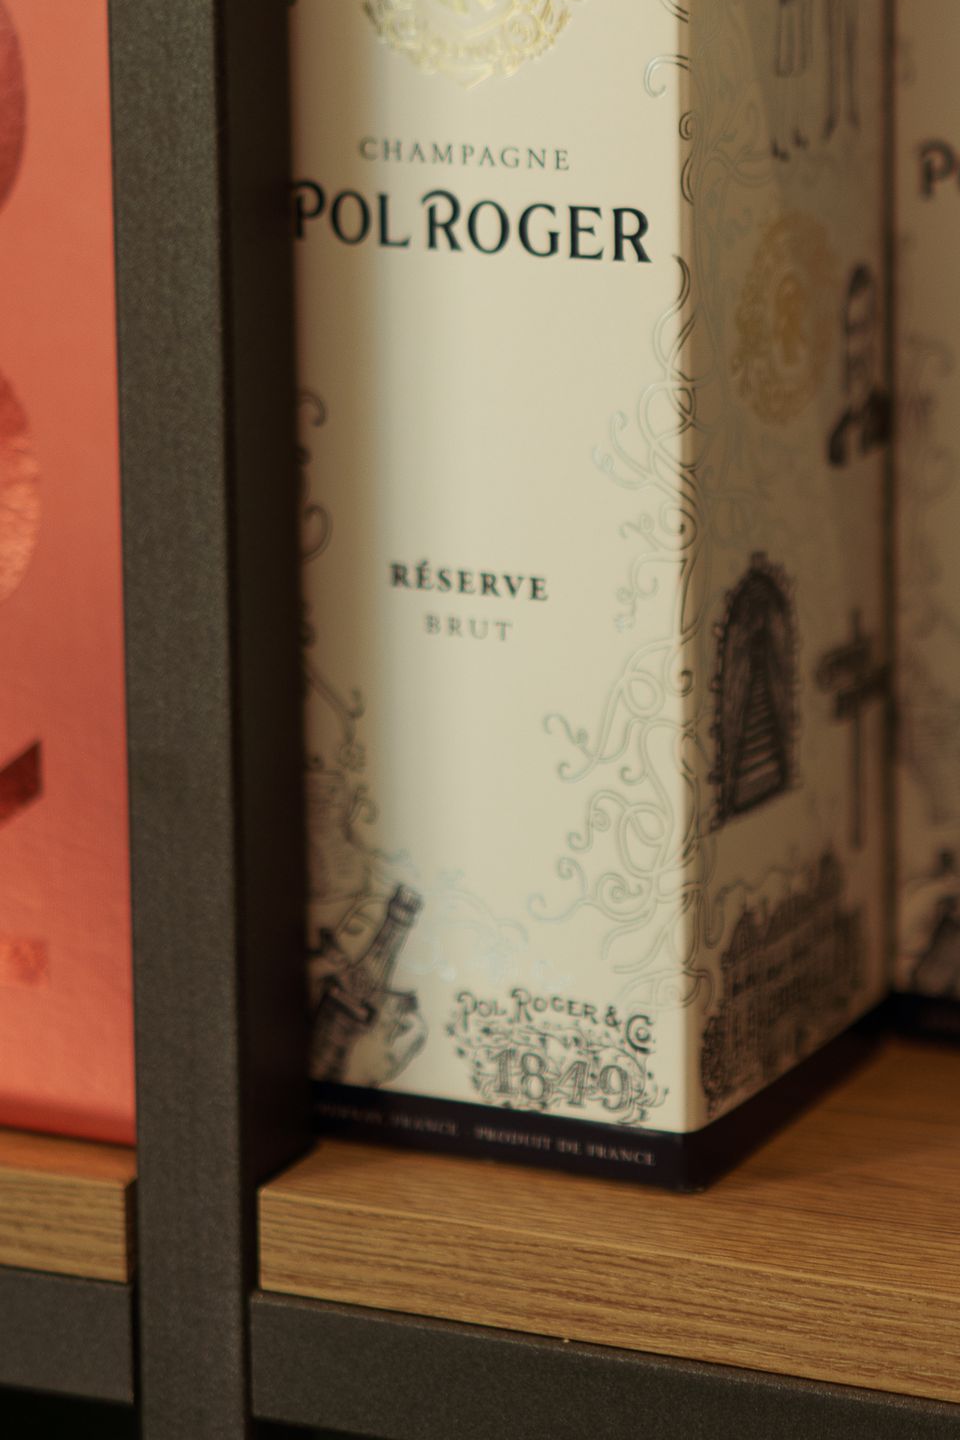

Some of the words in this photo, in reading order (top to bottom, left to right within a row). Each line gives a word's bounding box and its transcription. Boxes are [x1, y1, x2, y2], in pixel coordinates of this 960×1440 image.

[357, 135, 571, 172] CHAMPAGNE
[293, 178, 412, 248] POL
[420, 187, 654, 265] ROGER
[388, 558, 549, 602] RÉSERVE
[425, 613, 513, 642] BRUT
